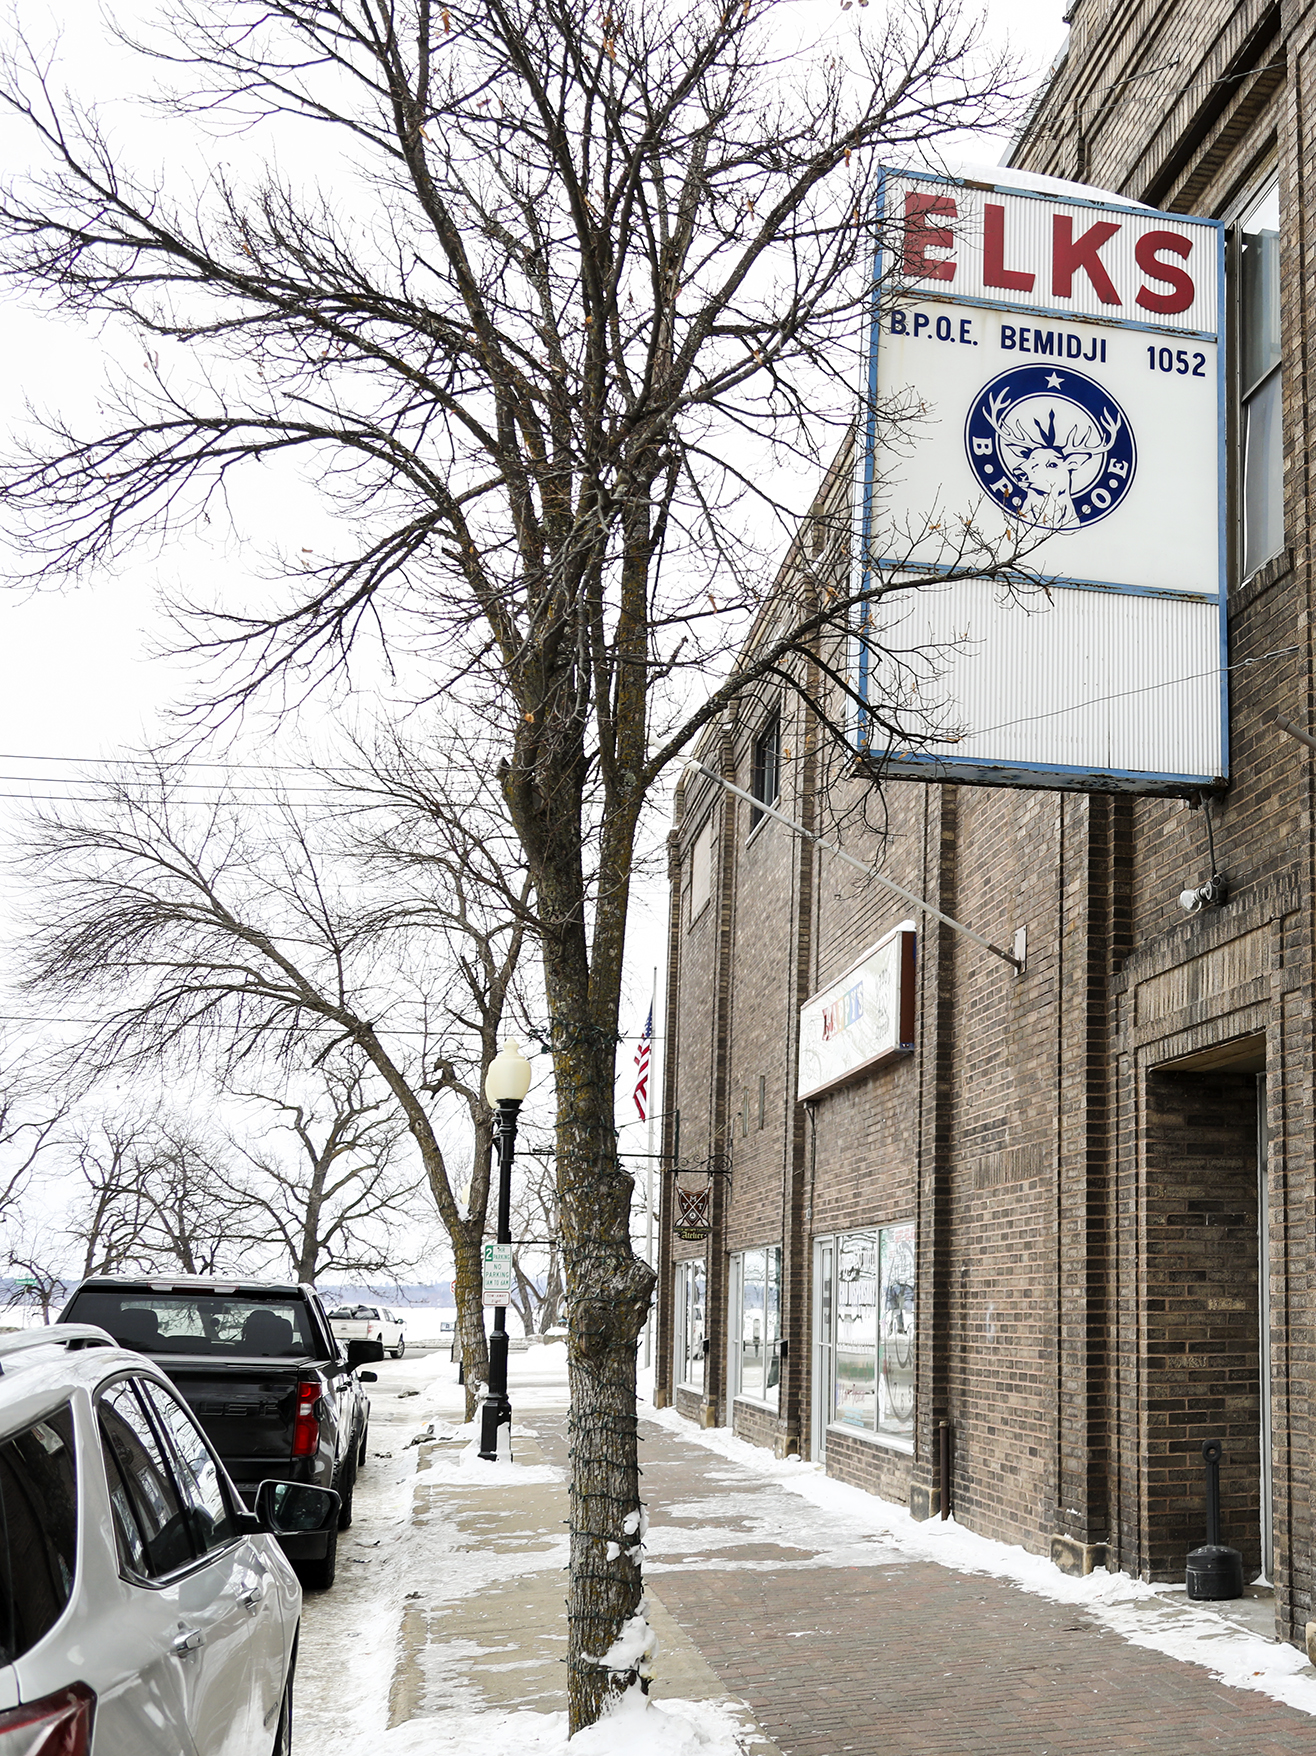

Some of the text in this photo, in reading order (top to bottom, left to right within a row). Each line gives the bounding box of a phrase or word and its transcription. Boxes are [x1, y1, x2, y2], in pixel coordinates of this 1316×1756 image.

[904, 191, 1195, 314] ELKS
[890, 311, 1207, 378] B.P.O.E. BEMIDJI 1052
[486, 1248, 492, 1260] 2
[485, 1271, 510, 1279] PARKING
